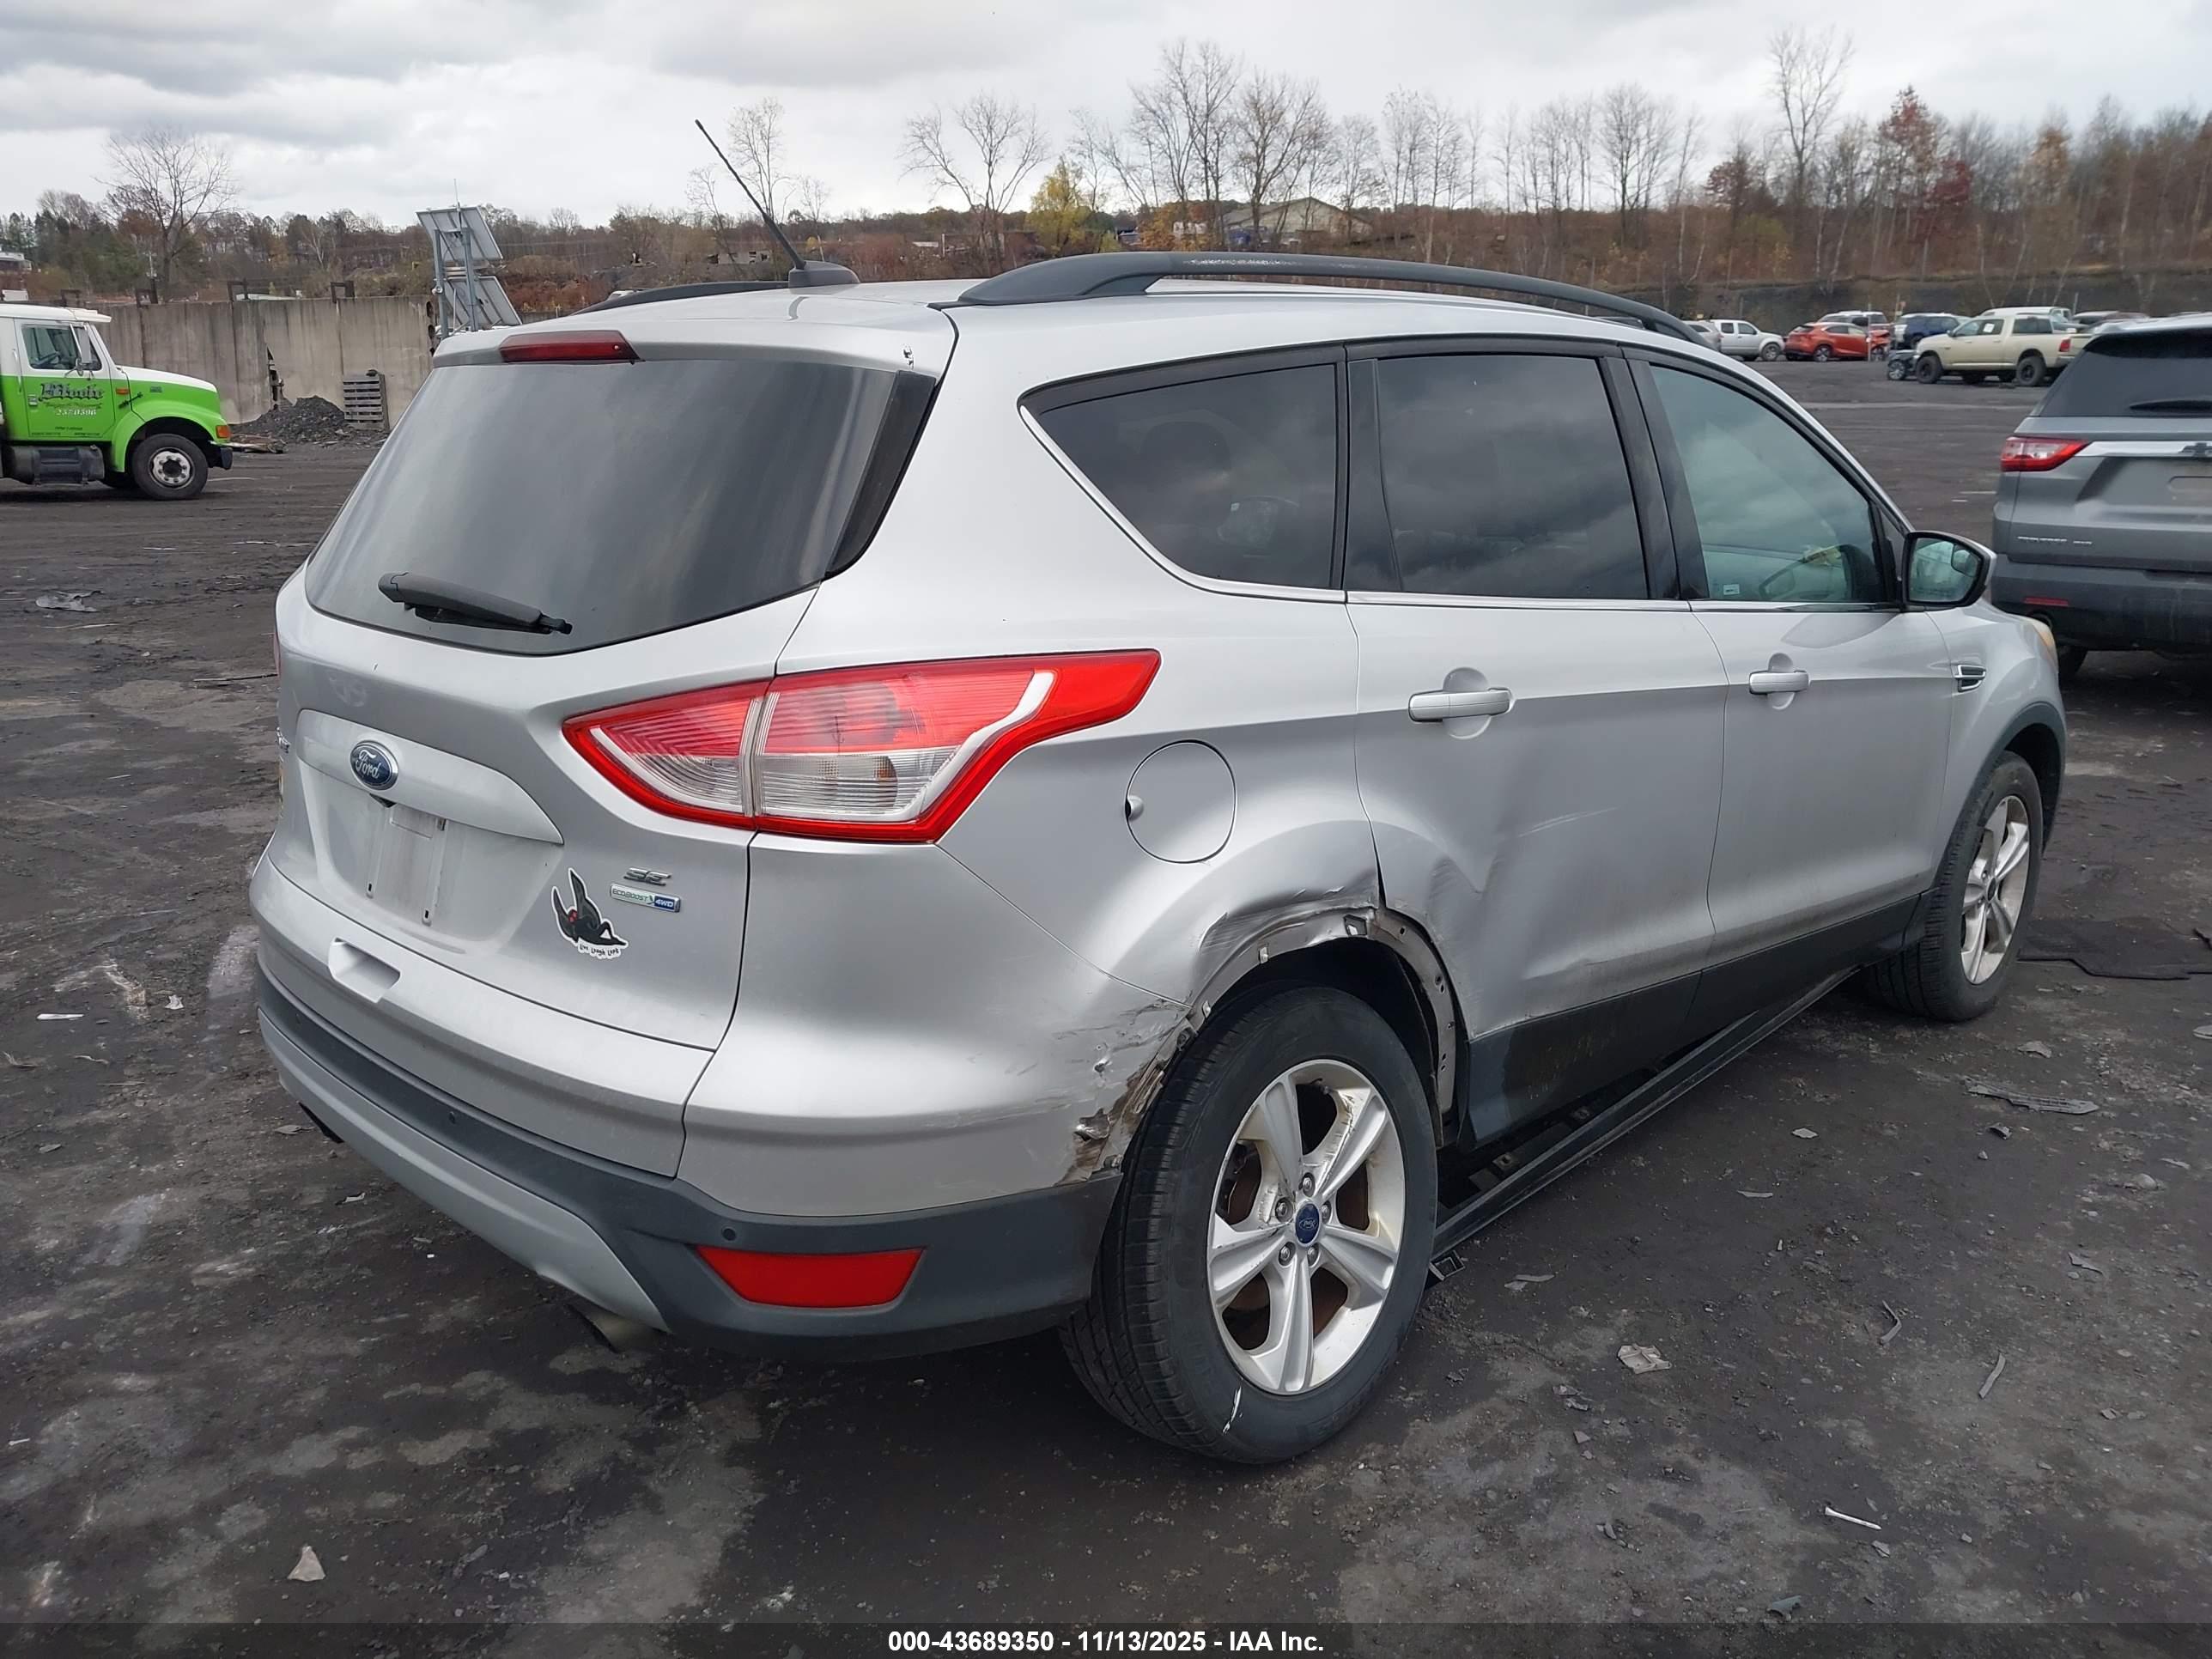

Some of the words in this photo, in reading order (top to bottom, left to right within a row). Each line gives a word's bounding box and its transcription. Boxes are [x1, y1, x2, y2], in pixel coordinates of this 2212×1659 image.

[356, 750, 382, 779] Ford
[623, 867, 672, 886] SE
[654, 898, 675, 908] 4WD
